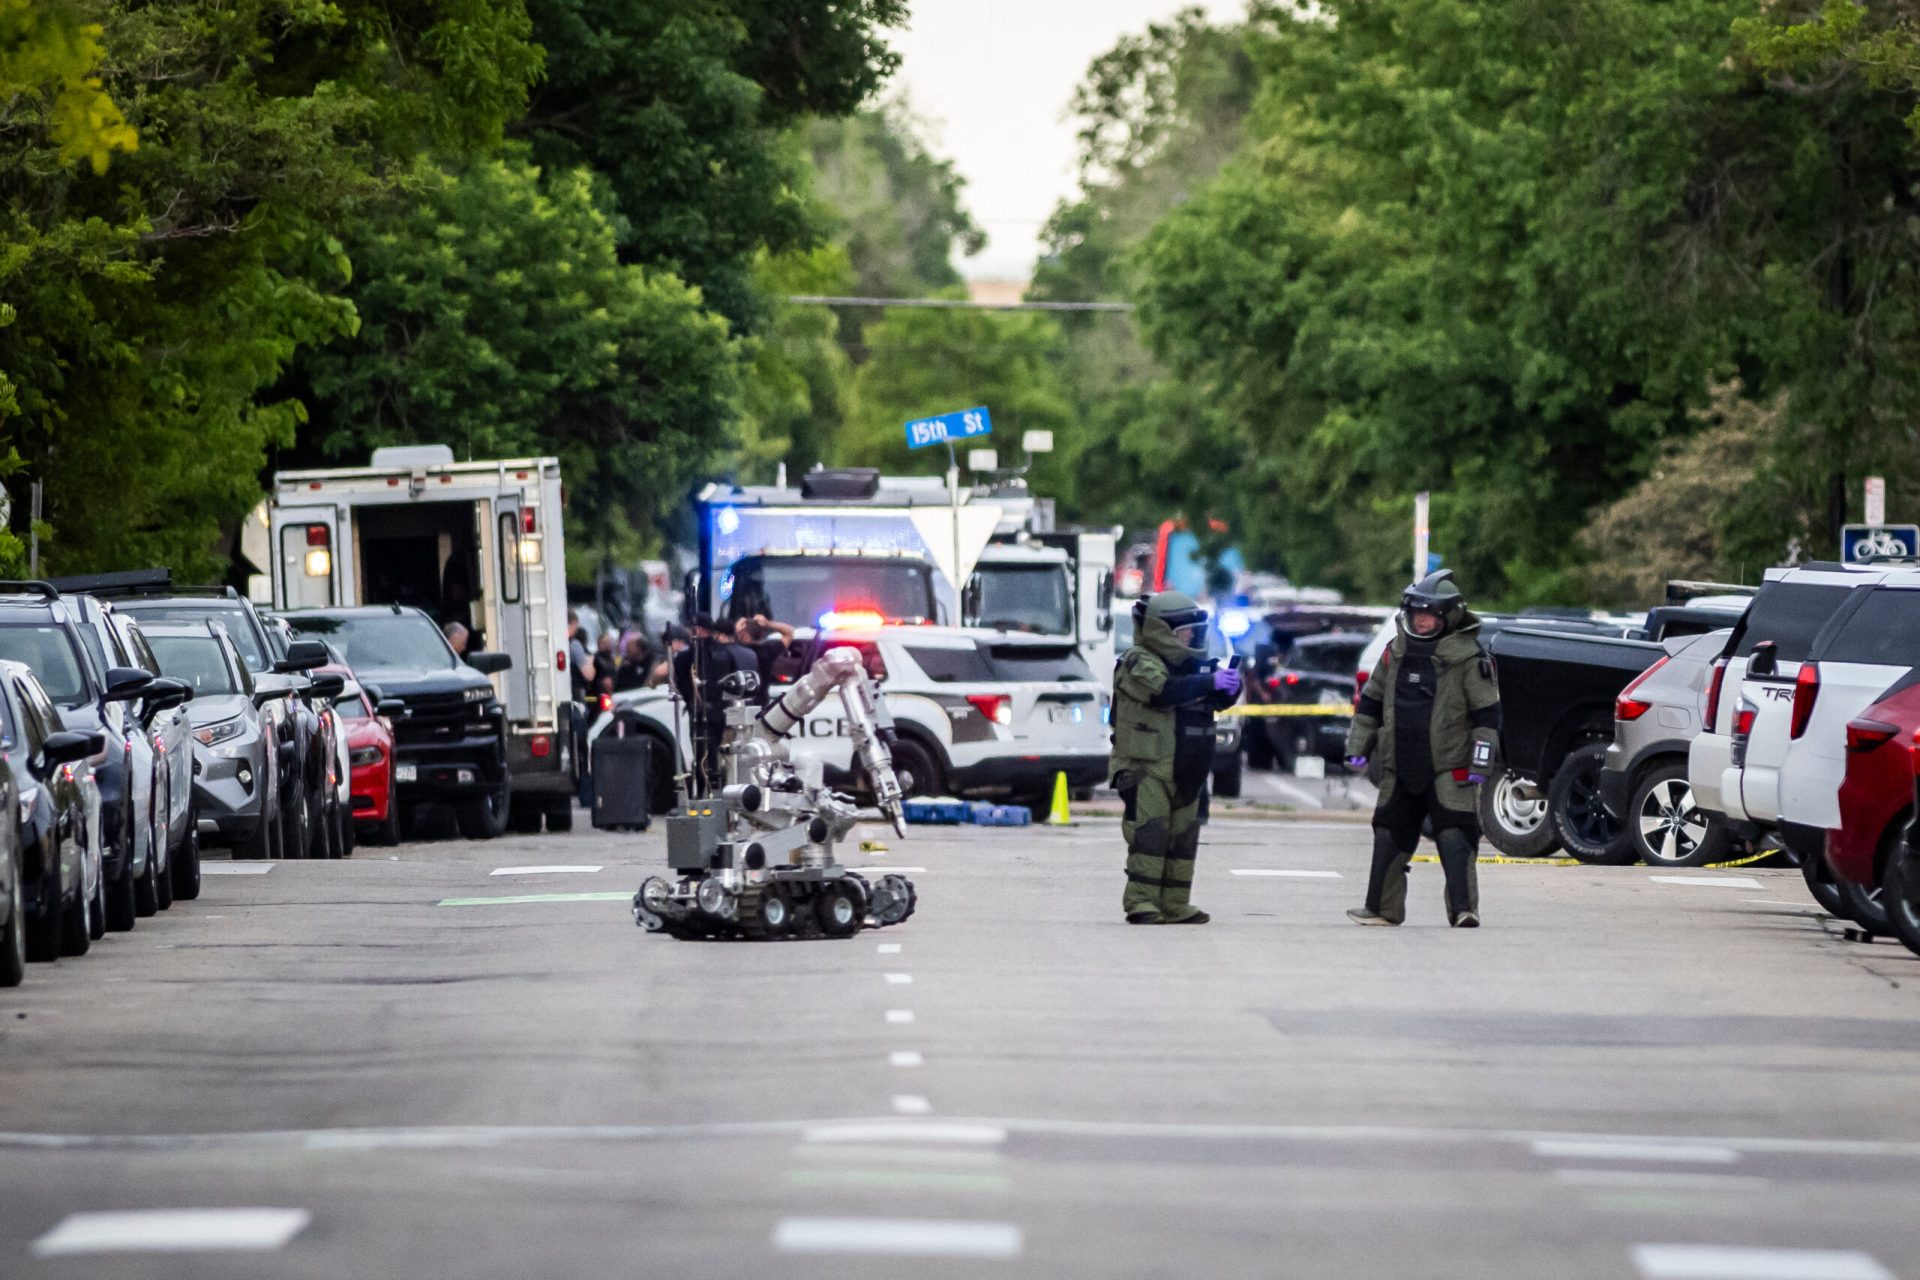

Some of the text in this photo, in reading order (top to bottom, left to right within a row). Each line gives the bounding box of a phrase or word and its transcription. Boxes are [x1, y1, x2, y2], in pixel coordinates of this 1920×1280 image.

[911, 411, 984, 444] 15th St
[790, 718, 850, 737] ICE
